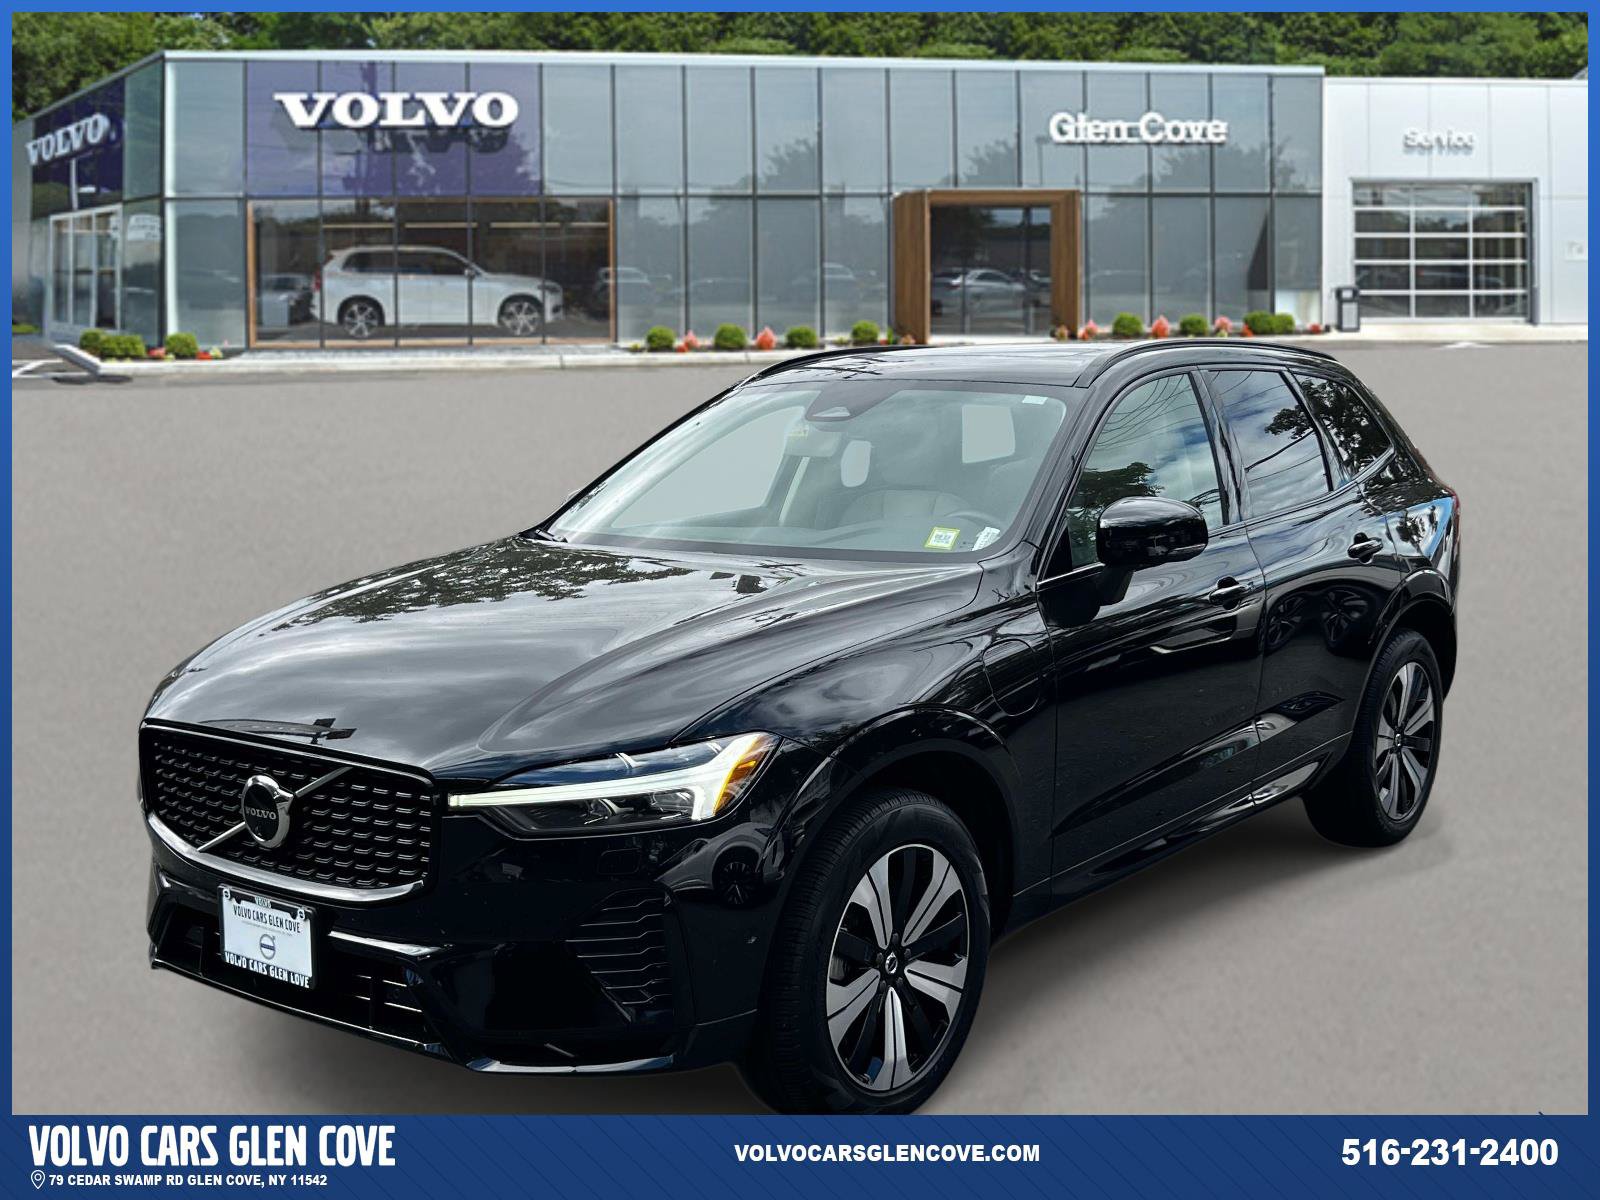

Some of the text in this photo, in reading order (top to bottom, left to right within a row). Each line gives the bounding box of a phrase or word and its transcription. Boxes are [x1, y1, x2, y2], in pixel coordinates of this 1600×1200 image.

[273, 92, 519, 128] VOLVO
[25, 113, 110, 165] VOLVO
[1049, 112, 1228, 143] Glen Cove
[1402, 127, 1476, 152] Service
[245, 806, 277, 820] VOLVO
[233, 904, 252, 920] VOLVO
[252, 909, 268, 925] CARS
[268, 914, 284, 929] GLEN
[285, 917, 301, 934] COVE
[225, 951, 310, 989] VOLVO CARS GLEN COVE
